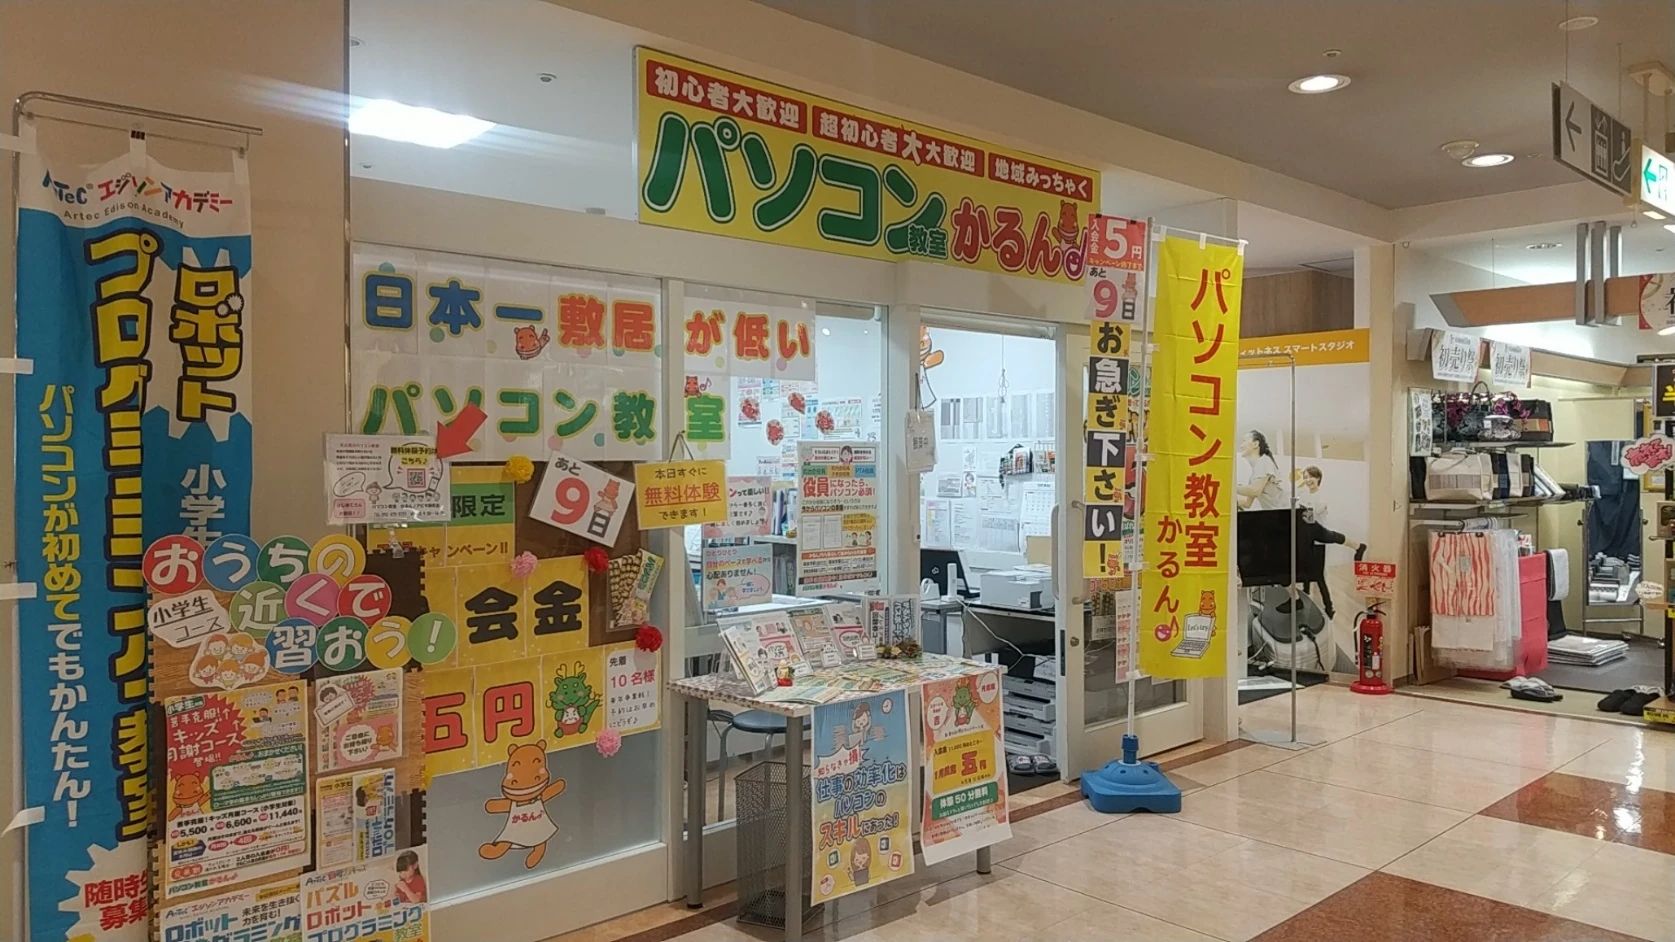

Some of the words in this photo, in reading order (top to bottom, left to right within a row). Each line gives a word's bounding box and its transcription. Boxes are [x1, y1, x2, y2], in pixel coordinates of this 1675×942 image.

[654, 66, 800, 128] 初心者大歓迎
[819, 113, 975, 172] 超初心者大大歓迎
[994, 158, 1088, 198] 地域みっちゃく
[643, 111, 947, 253] パソコン
[906, 223, 948, 259] 教室
[951, 197, 1062, 275] かるん
[64, 210, 100, 221] Artec
[1090, 219, 1099, 254] 入会金
[1103, 218, 1127, 260] 5
[1131, 245, 1143, 260] 円
[1089, 266, 1107, 278] あと
[1094, 279, 1118, 320] 9
[1122, 298, 1135, 320] 日
[170, 264, 244, 422] ロボット
[1284, 340, 1355, 354] スマートスタジオ
[1184, 268, 1231, 568] パソコン教室
[555, 457, 582, 476] あと
[655, 467, 707, 479] 本日すぐに
[644, 482, 721, 504] 無料体験
[803, 476, 829, 498] 役員
[830, 487, 876, 497] パソコン必須!
[452, 495, 505, 518] 限定
[551, 477, 590, 524] 9
[587, 511, 610, 538] 日
[659, 508, 707, 521] できます!
[151, 541, 354, 584] おうちの
[706, 568, 757, 580] 心配ありません!
[1154, 515, 1183, 615] かるん
[1359, 563, 1392, 572] 消火器
[153, 594, 212, 623] 小学生
[239, 579, 385, 630] 近くで
[465, 580, 583, 644] 会金
[177, 616, 224, 638] コース
[273, 620, 442, 667] 習おう!
[609, 656, 626, 667] 先着
[173, 718, 222, 743] キッズ
[423, 681, 535, 753] 五円
[167, 733, 242, 762] 月謝コース
[961, 750, 978, 777] 五
[816, 761, 907, 803] 仕事の効率化は
[270, 808, 298, 820] 11,440
[512, 813, 536, 823] かるん
[834, 789, 887, 819] パソコンの
[180, 825, 208, 838] 5,500
[226, 817, 252, 830] 6,600
[819, 811, 899, 851] スキルにあった!
[242, 893, 300, 916] 未来を生き抜く
[306, 881, 359, 909] パズル
[165, 913, 239, 942] ロボット
[243, 910, 281, 927] 力を育む!
[307, 901, 372, 930] ロボット
[307, 906, 422, 942] プログラミング
